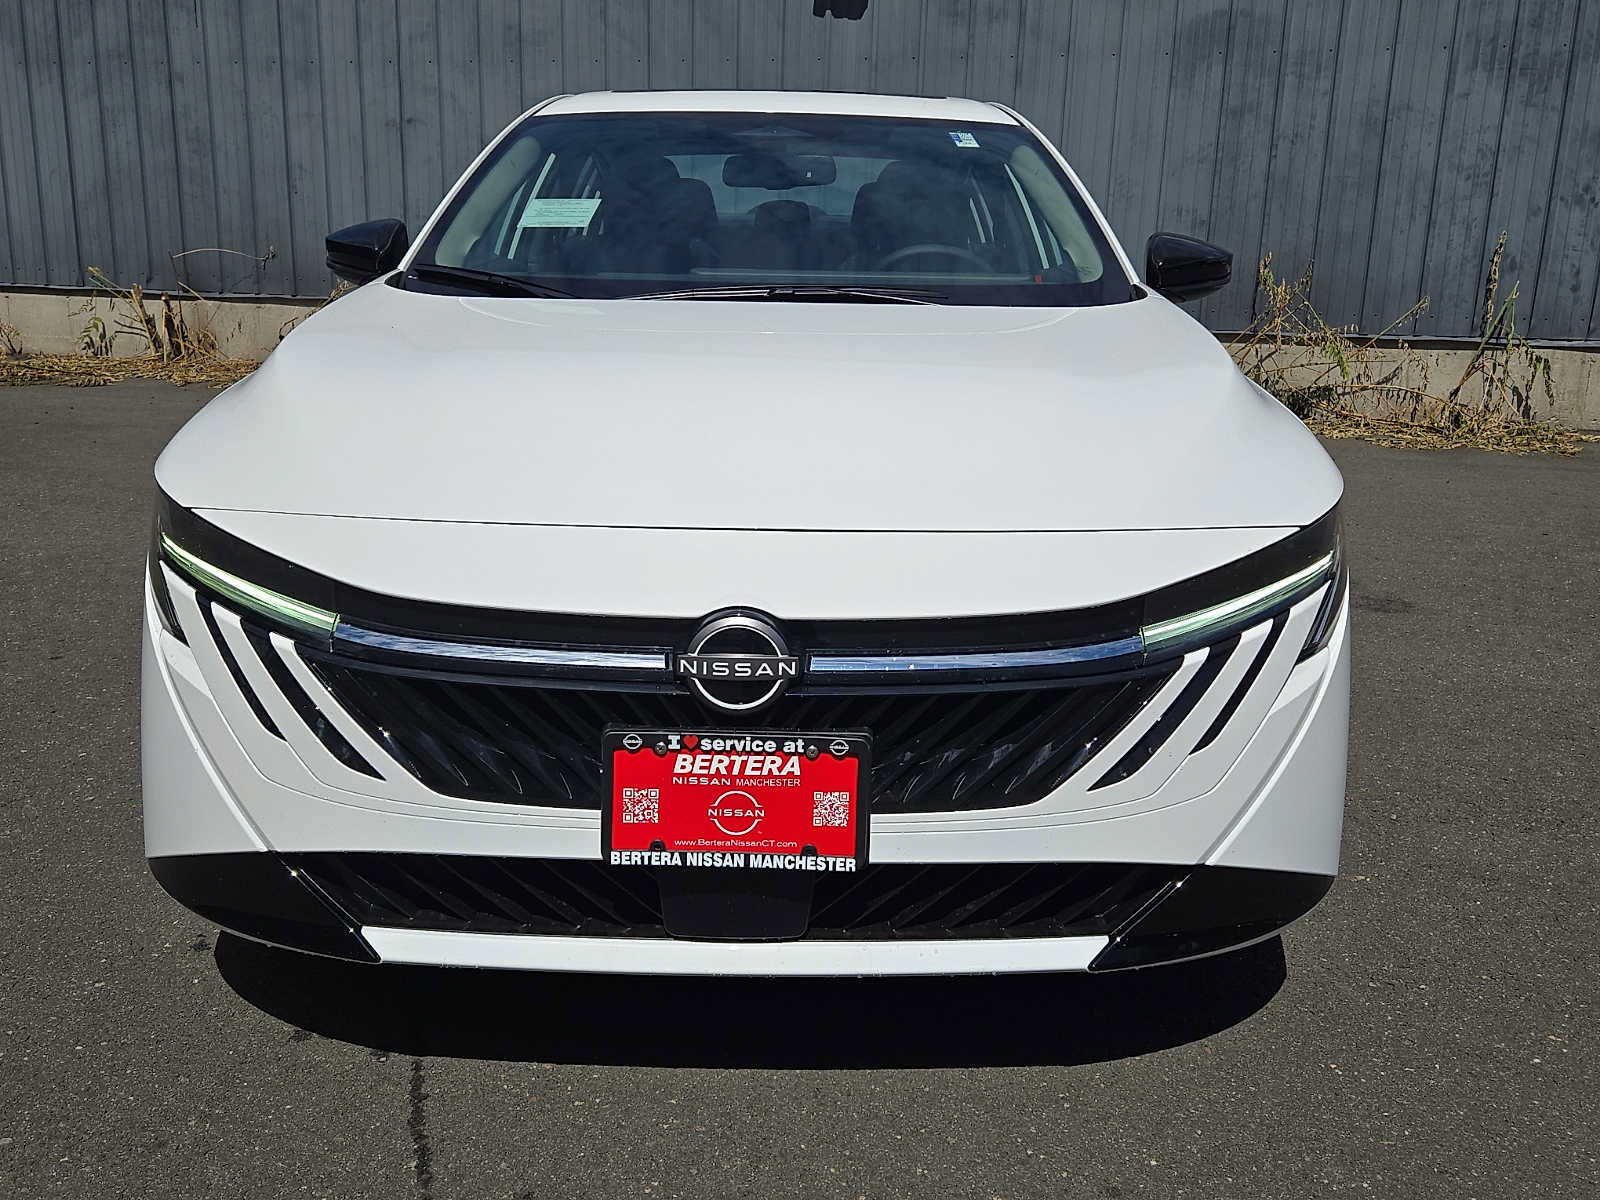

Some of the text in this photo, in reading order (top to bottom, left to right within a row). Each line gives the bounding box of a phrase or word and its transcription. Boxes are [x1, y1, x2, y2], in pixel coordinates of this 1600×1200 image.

[680, 659, 797, 677] NISSAN
[668, 735, 805, 753] I service at
[673, 753, 801, 776] BERTERA
[672, 776, 801, 788] NISSAN MANCHESTER
[708, 808, 765, 817] NISSAN
[674, 838, 798, 849] www.BerteraNissanCT.com
[610, 851, 857, 873] BERTERA NISSAN MANCHESTER
